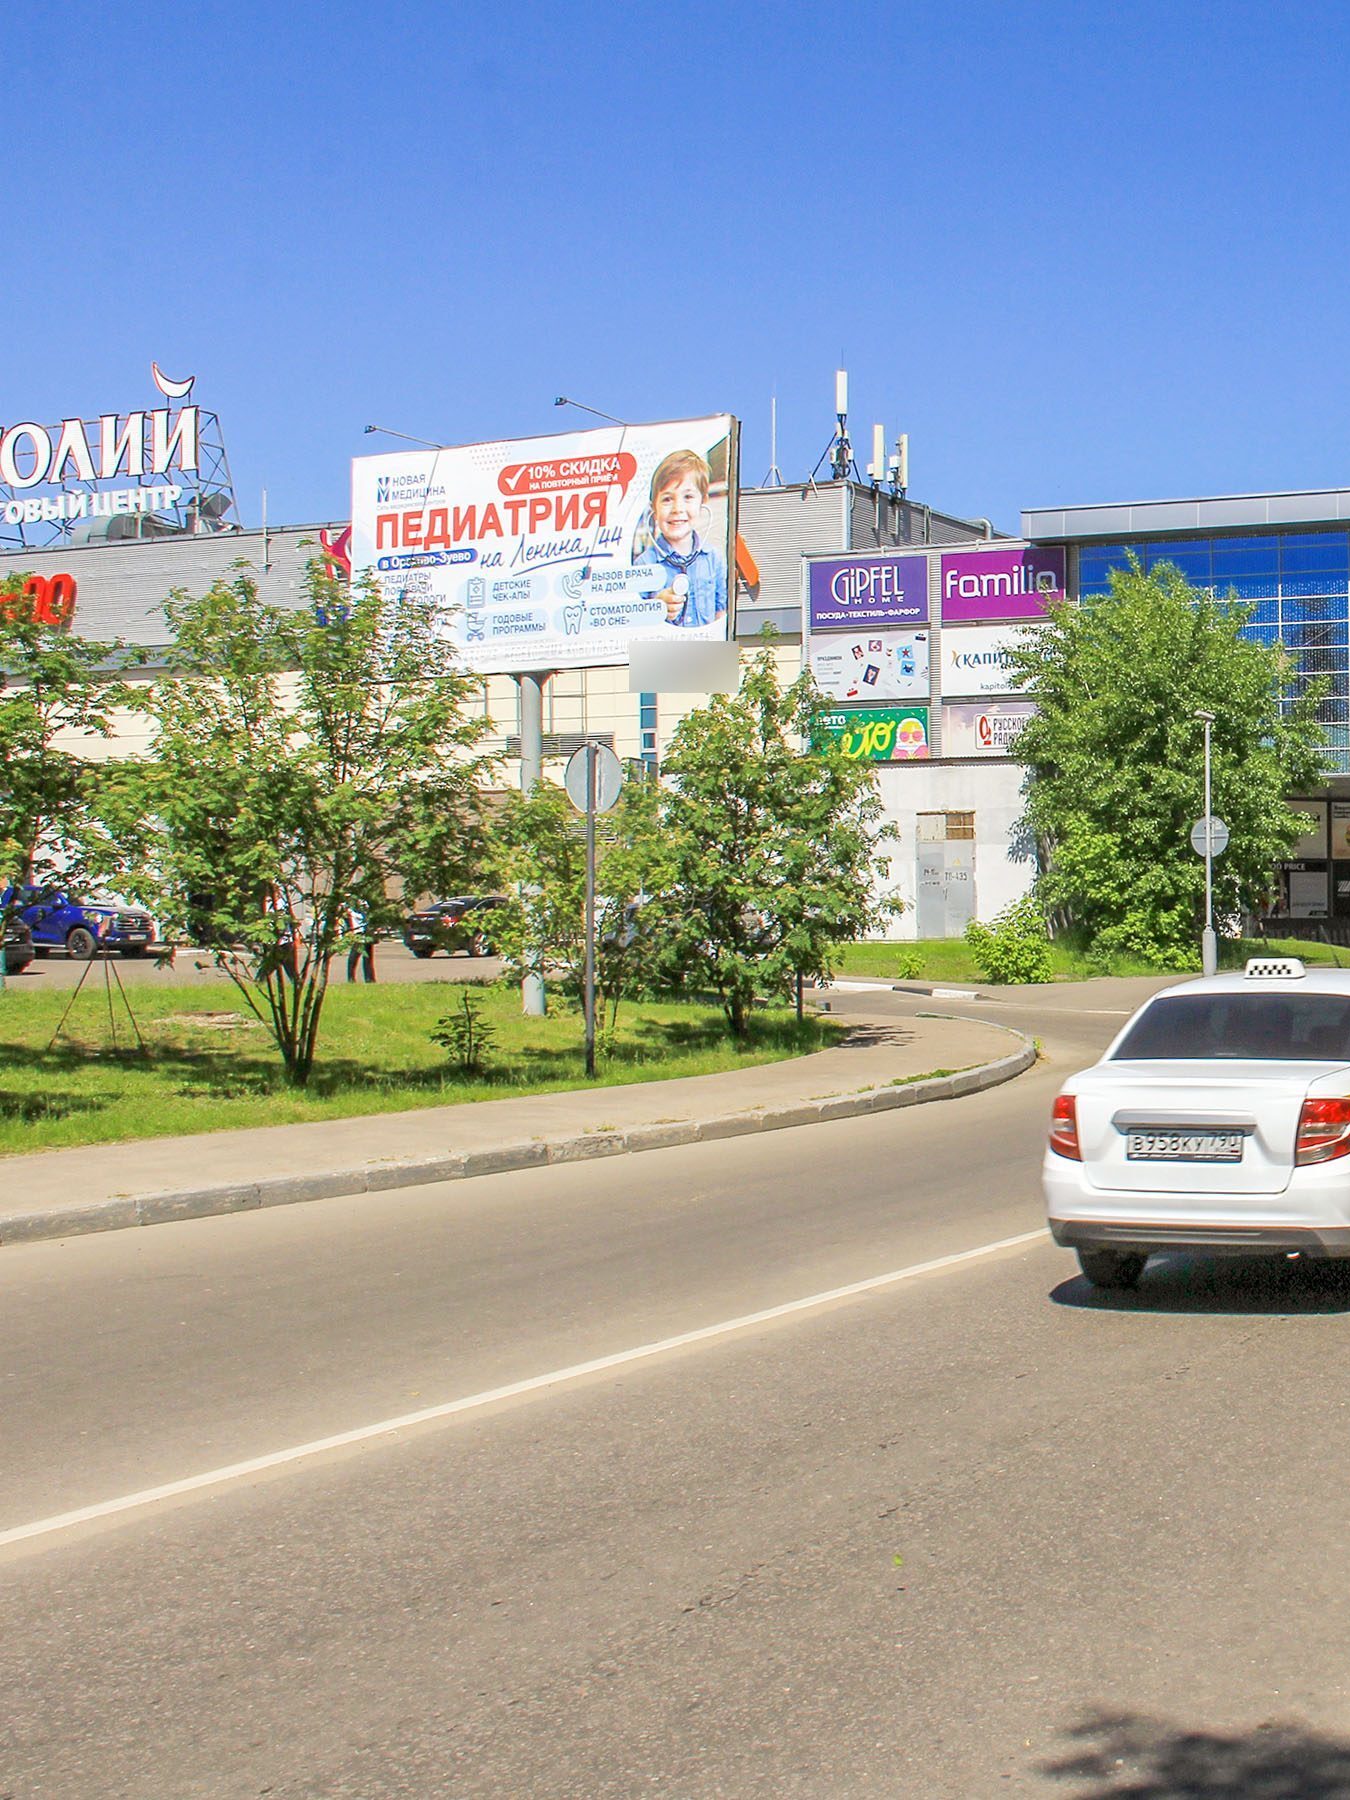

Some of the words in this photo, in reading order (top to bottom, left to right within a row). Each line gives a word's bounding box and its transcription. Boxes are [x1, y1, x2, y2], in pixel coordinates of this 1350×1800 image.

[0, 365, 200, 489] ОЛИЙ
[528, 465, 556, 480] 10%
[560, 456, 621, 477] СКИДКА
[392, 474, 426, 487] НОВАЯ
[529, 482, 540, 490] НА
[541, 475, 590, 489] ПОВТОРНЫЙ
[392, 486, 446, 500] МЕДИЦИНА
[0, 490, 88, 525] ОВЫЙ
[92, 484, 183, 517] ЦЕНТР
[376, 491, 607, 551] ПЕДИАТРИЯ
[480, 551, 504, 568] на
[598, 526, 623, 548] 44
[592, 570, 623, 581] ВЫЗОВ
[625, 568, 653, 579] ВРАЧА
[492, 579, 531, 591] ДЕТСКИЕ
[591, 583, 603, 592] НА
[605, 582, 626, 593] ДОМ
[492, 590, 530, 601] ЧЕК-АПЫ
[590, 602, 662, 616] СТОМАТОЛОГИЯ
[493, 612, 533, 624] ГОДОВЫЕ
[493, 623, 546, 635] ПРОГРАММЫ
